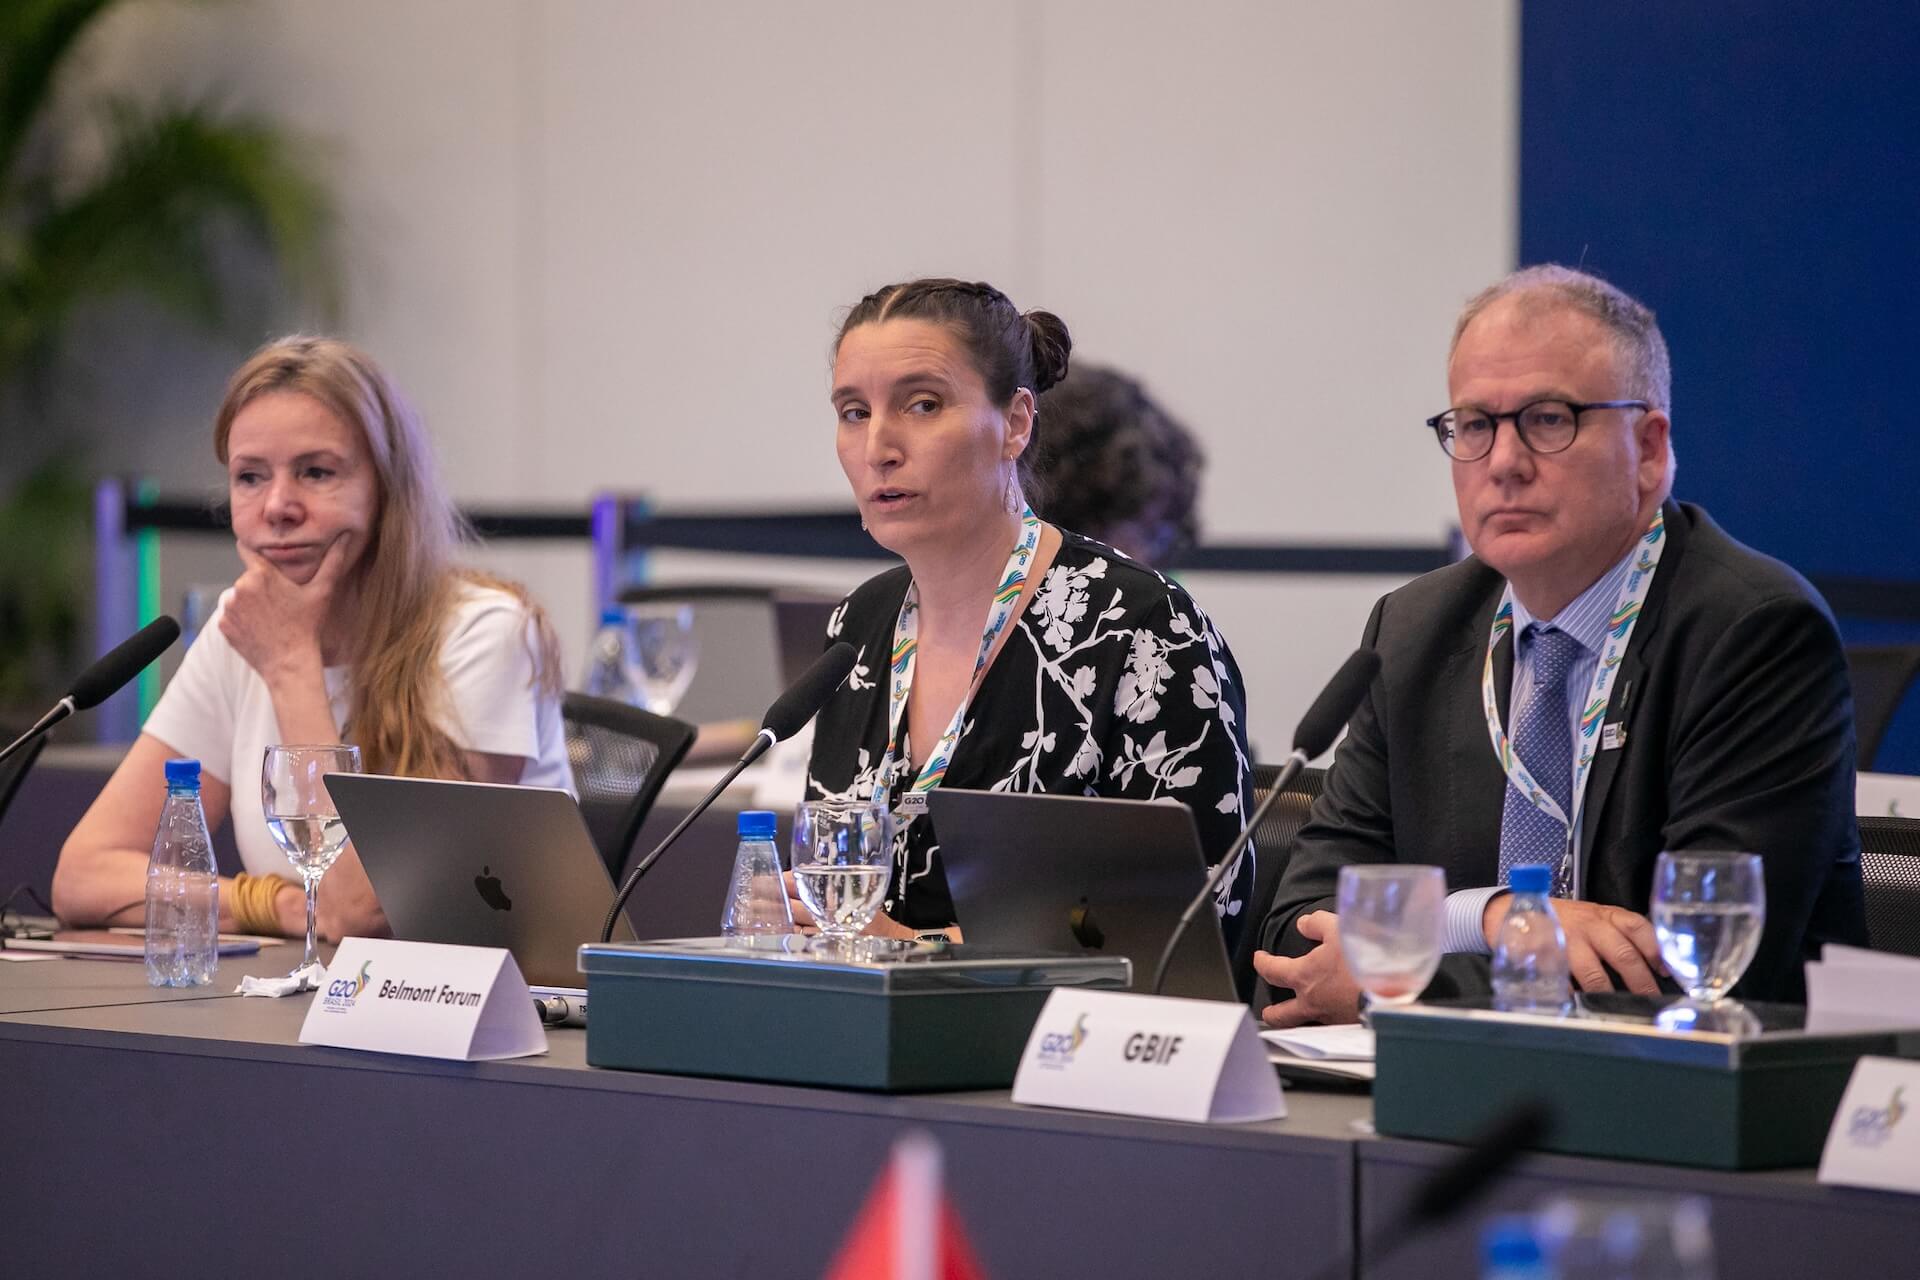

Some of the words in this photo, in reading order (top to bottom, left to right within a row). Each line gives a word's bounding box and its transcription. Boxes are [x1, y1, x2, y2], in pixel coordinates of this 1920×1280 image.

[328, 979, 357, 998] G20
[378, 979, 437, 1002] Belmont
[437, 984, 482, 1007] Forum
[1041, 1033, 1073, 1053] G20
[1123, 1033, 1183, 1065] GBIF
